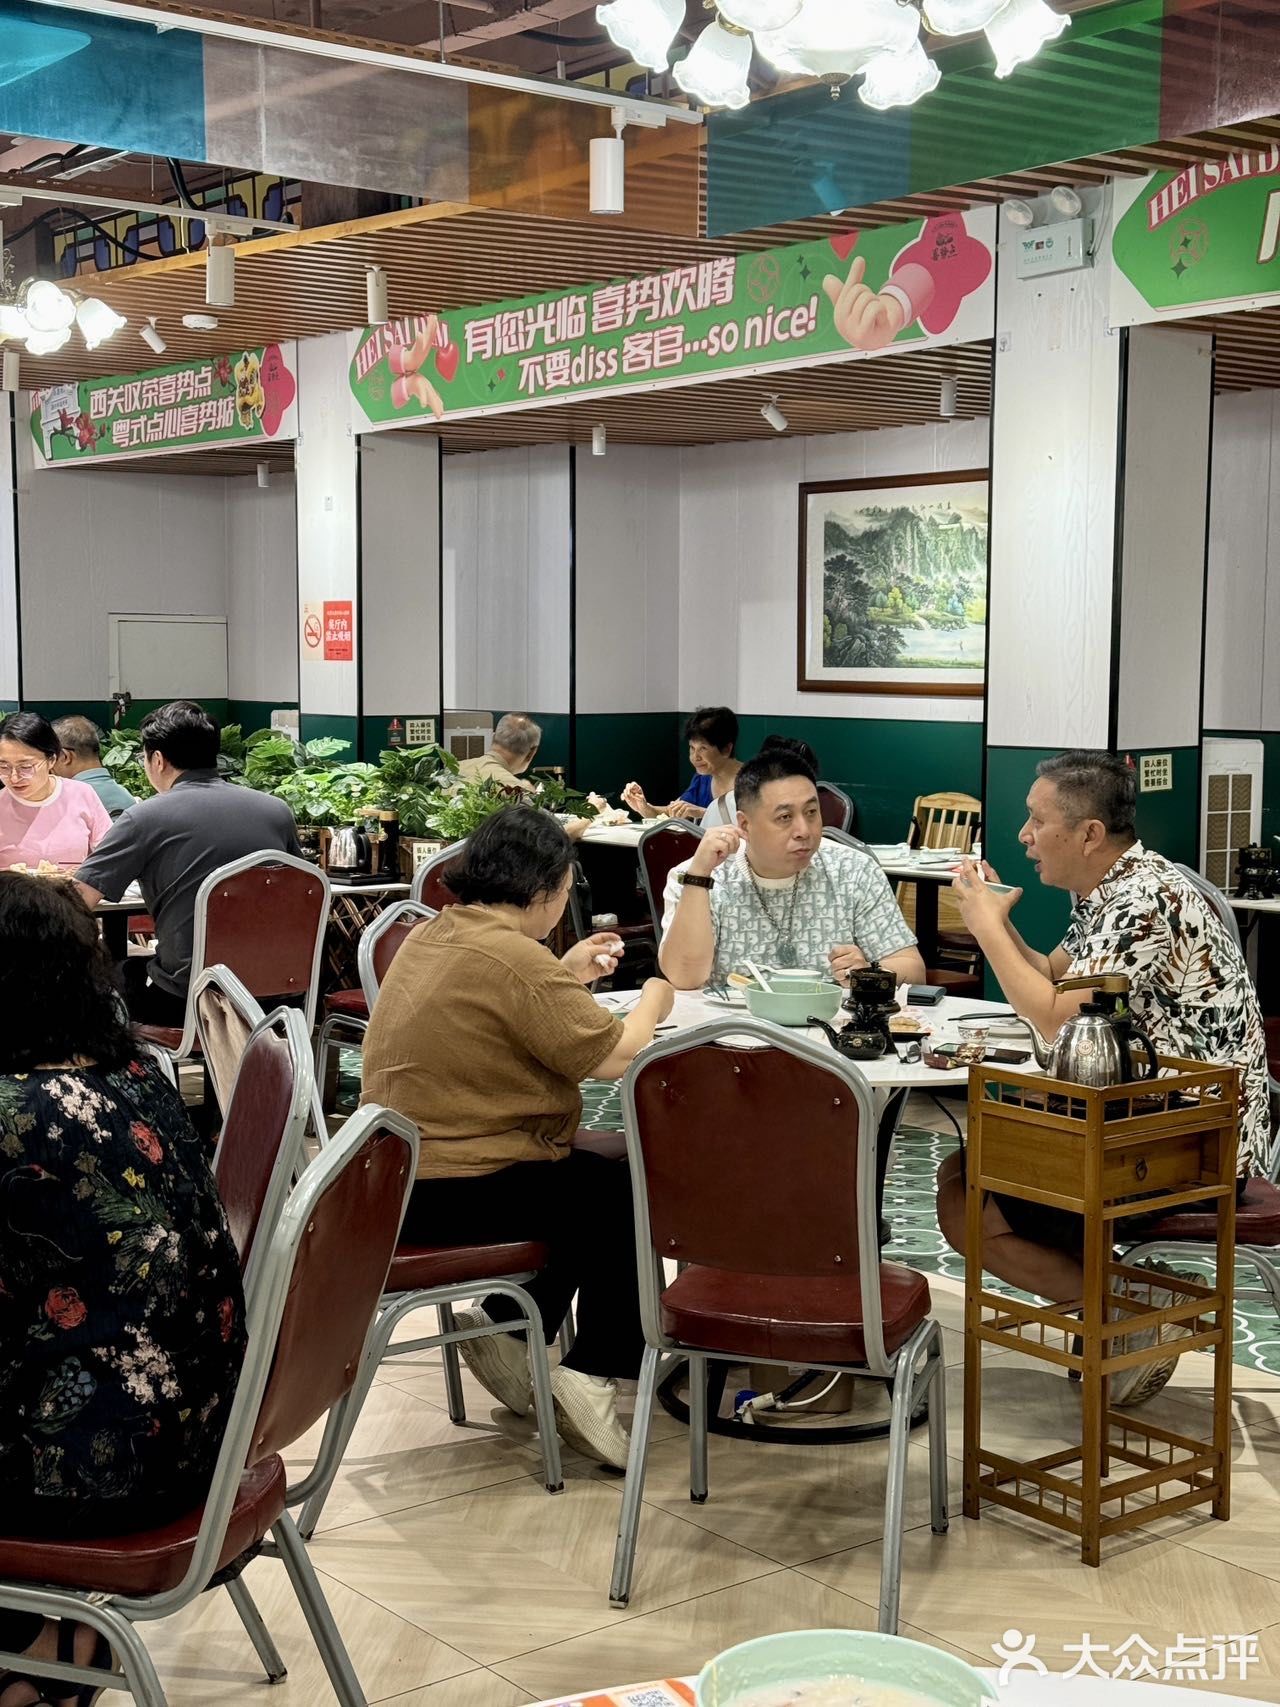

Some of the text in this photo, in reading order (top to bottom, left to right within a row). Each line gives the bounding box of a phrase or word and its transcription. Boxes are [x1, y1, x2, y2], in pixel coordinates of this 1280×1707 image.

[1149, 165, 1199, 228] HEI
[1202, 152, 1252, 191] SAI
[464, 256, 736, 364] 有您光临 喜势欢腾
[743, 294, 819, 350] nice!
[355, 327, 384, 382] HEI
[90, 365, 213, 420] 西关叹茶喜势点
[112, 396, 236, 448] 粤式点心喜势掂
